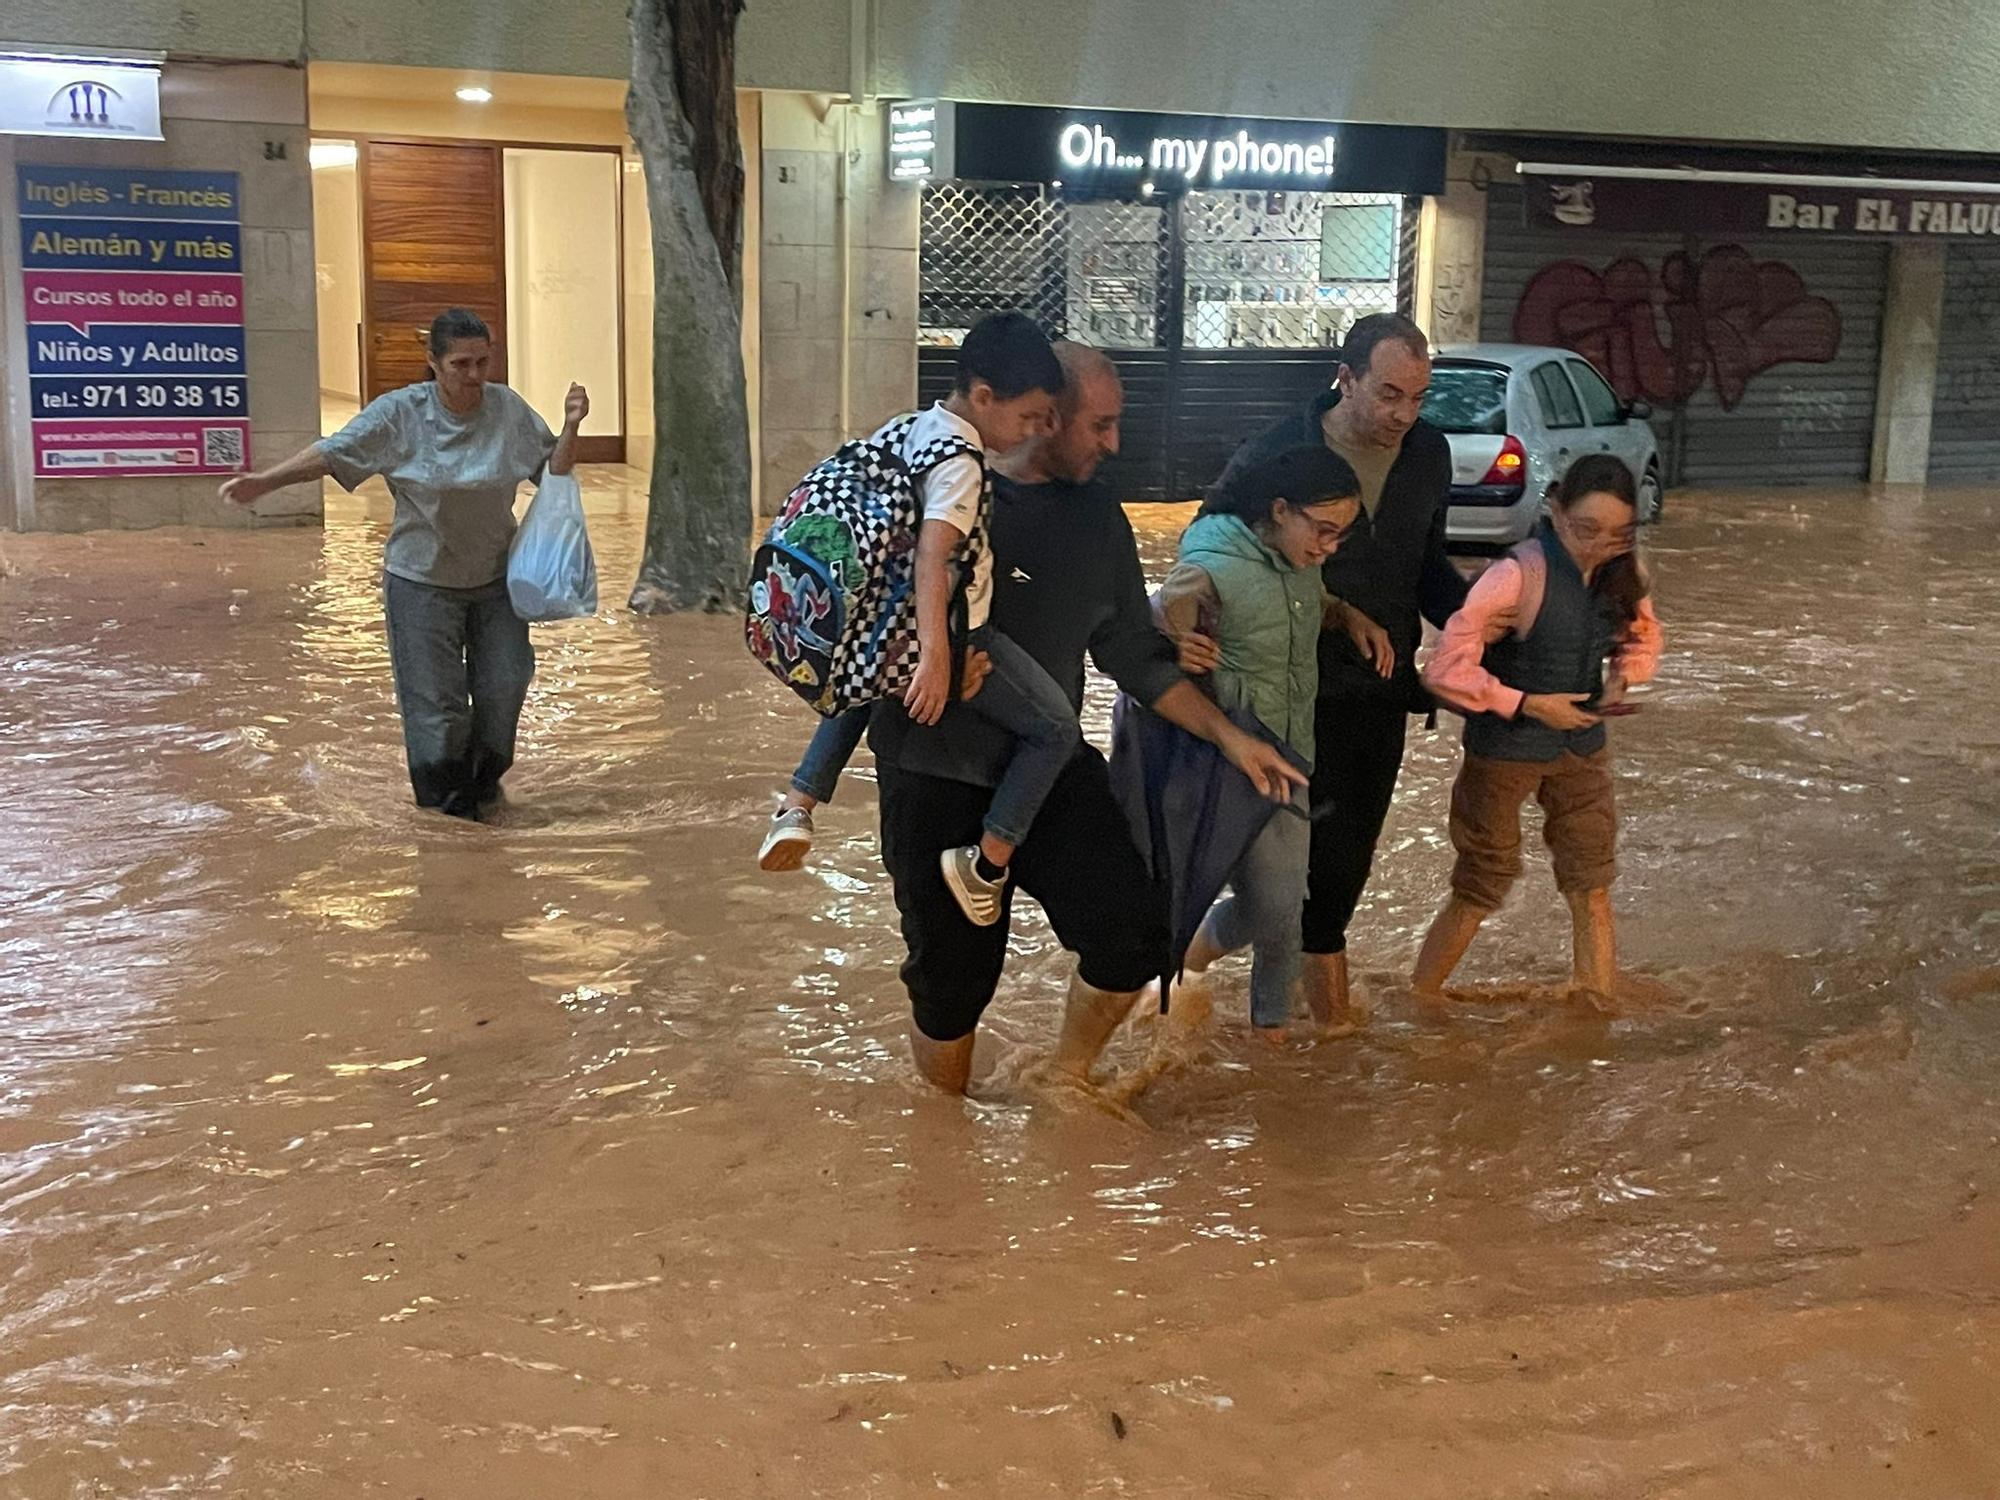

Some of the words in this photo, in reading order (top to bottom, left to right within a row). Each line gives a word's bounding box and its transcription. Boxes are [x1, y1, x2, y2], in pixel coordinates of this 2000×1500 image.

[1060, 123, 1144, 167] Oh...
[1152, 137, 1208, 179] my
[1213, 129, 1335, 180] phone!
[26, 180, 109, 207] Inglés
[130, 183, 232, 208] Francés
[1767, 194, 1839, 230] Bar
[1855, 198, 1898, 232] EL
[30, 231, 141, 256] Alemán
[149, 239, 167, 262] y
[174, 235, 233, 259] más
[32, 287, 112, 305] Cursos
[118, 289, 168, 306] todo
[173, 290, 192, 307] el
[197, 291, 237, 307] año
[38, 341, 113, 362] Niños
[119, 345, 135, 367] y
[142, 342, 239, 363] Adultos
[82, 385, 127, 407] 971
[136, 385, 167, 407] 30
[173, 385, 204, 407] 38
[210, 386, 240, 407] 15
